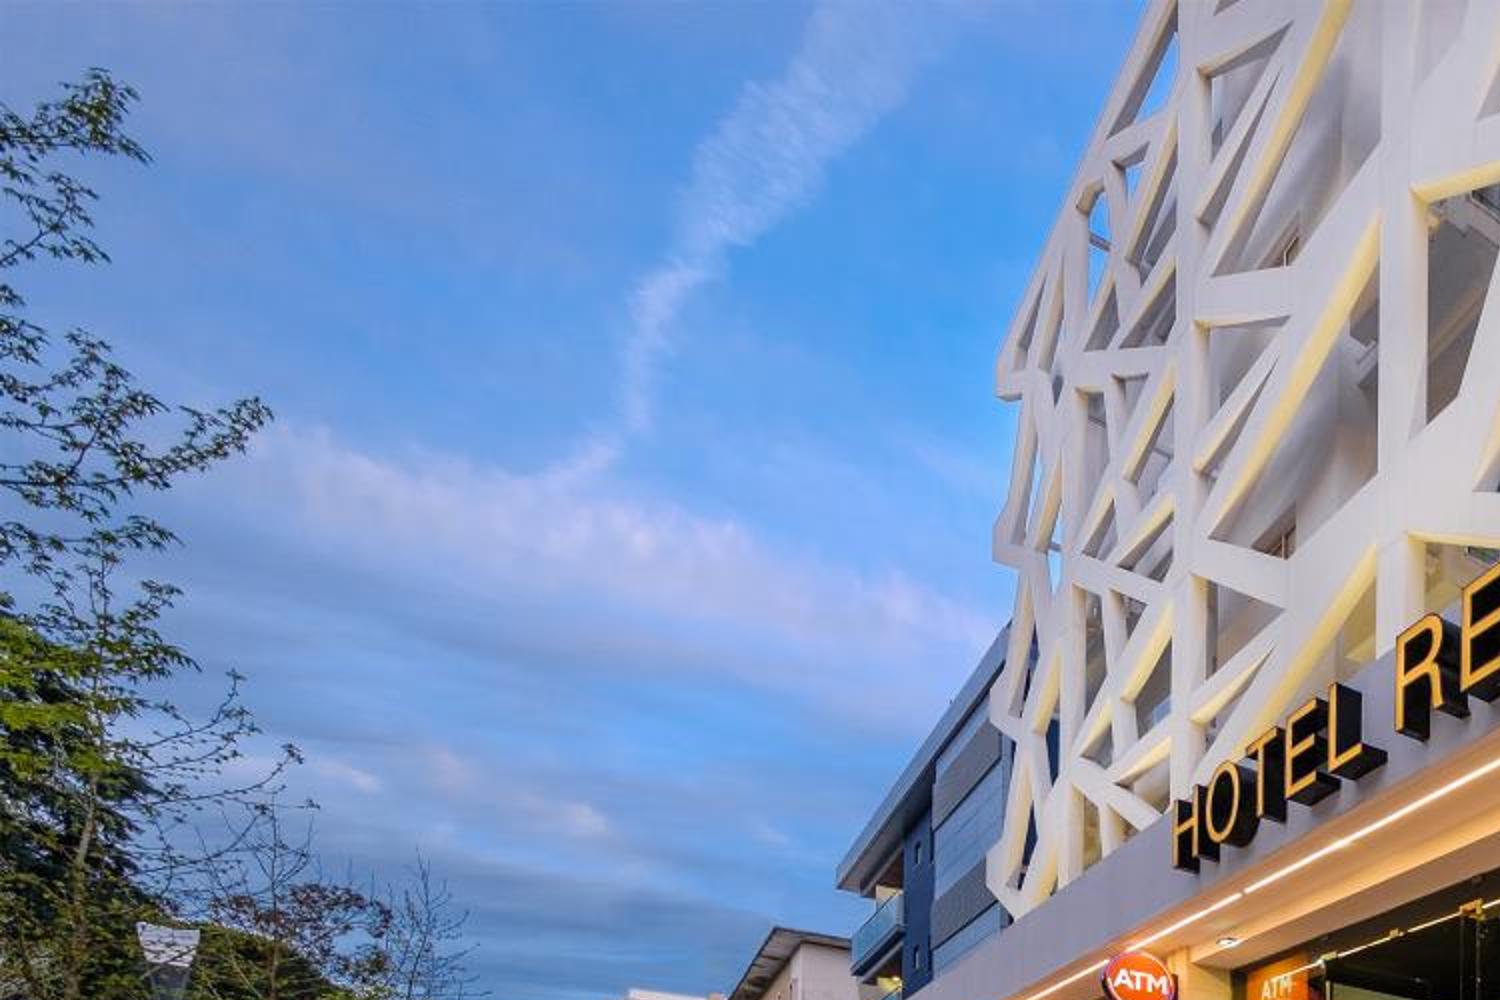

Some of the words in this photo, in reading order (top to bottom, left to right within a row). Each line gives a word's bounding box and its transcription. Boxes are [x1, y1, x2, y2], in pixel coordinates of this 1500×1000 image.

[1172, 681, 1384, 873] HOTEL
[1113, 967, 1169, 995] ATM
[1261, 974, 1293, 1000] ATM
